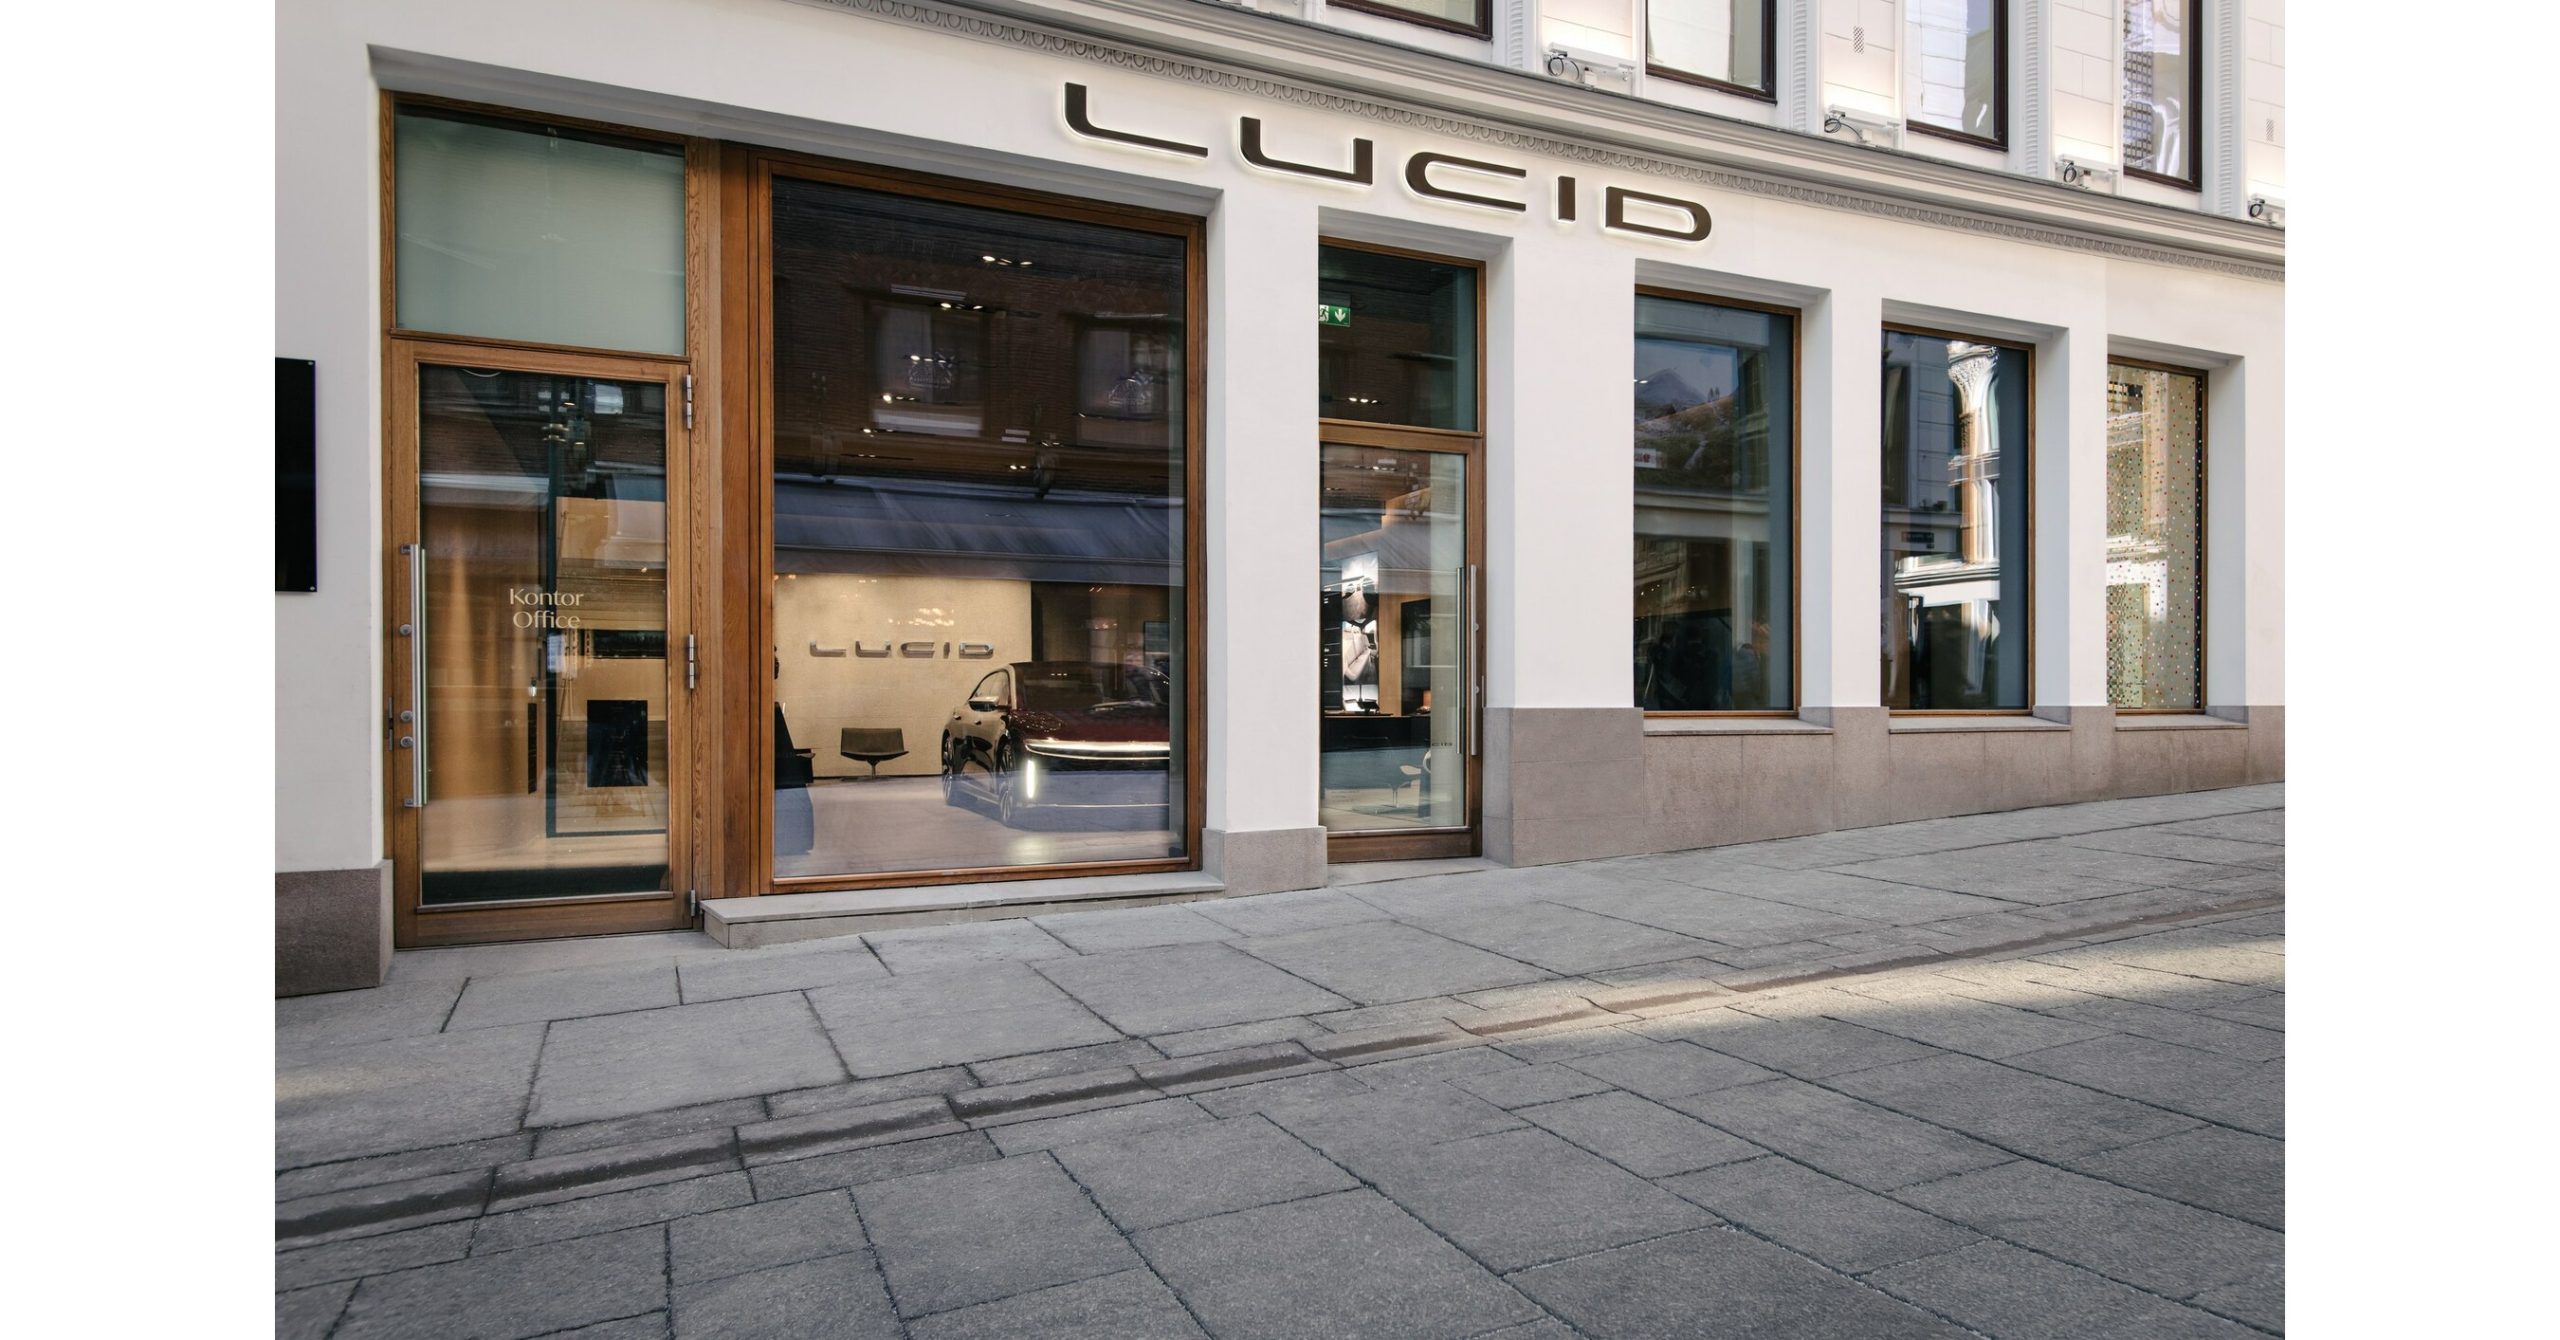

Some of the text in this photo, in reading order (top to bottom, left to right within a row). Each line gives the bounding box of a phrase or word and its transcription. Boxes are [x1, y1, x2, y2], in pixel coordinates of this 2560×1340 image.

[1063, 82, 1713, 243] LUCID
[509, 588, 585, 607] Kontor
[512, 610, 581, 629] Office
[809, 640, 995, 660] LUCID
